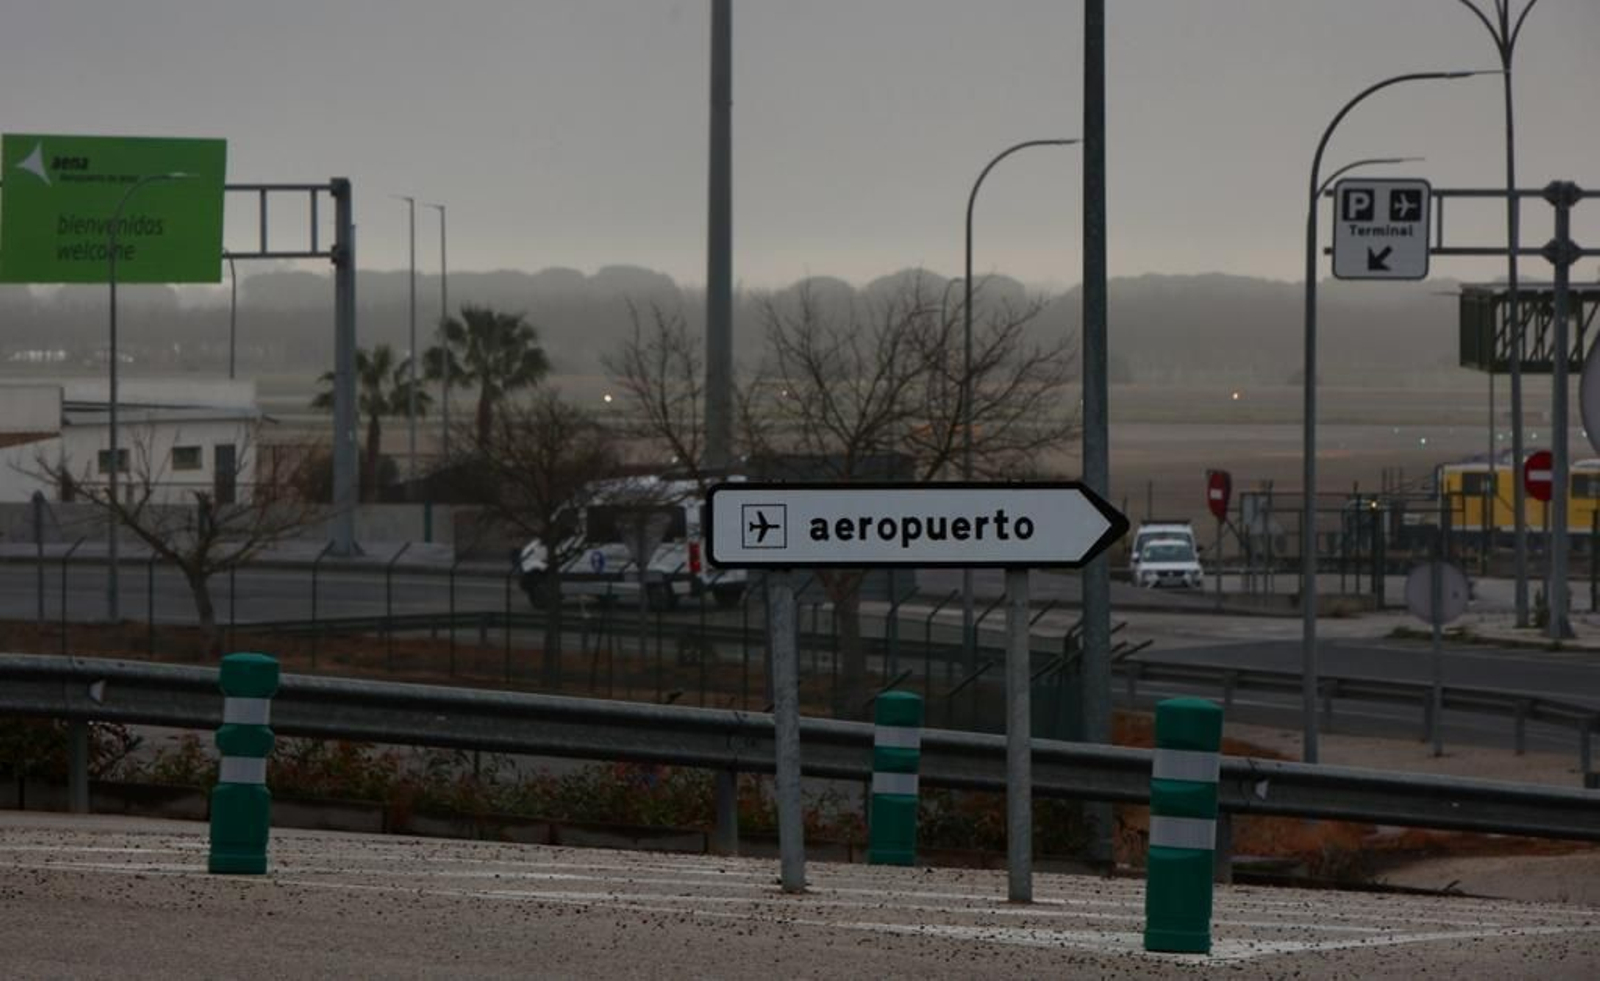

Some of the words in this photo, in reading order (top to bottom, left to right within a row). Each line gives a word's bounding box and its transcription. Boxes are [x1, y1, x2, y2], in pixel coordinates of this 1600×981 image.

[51, 156, 89, 170] aena
[1348, 191, 1370, 219] P
[1349, 224, 1413, 237] Terminal
[809, 509, 1034, 547] aeropuerto
